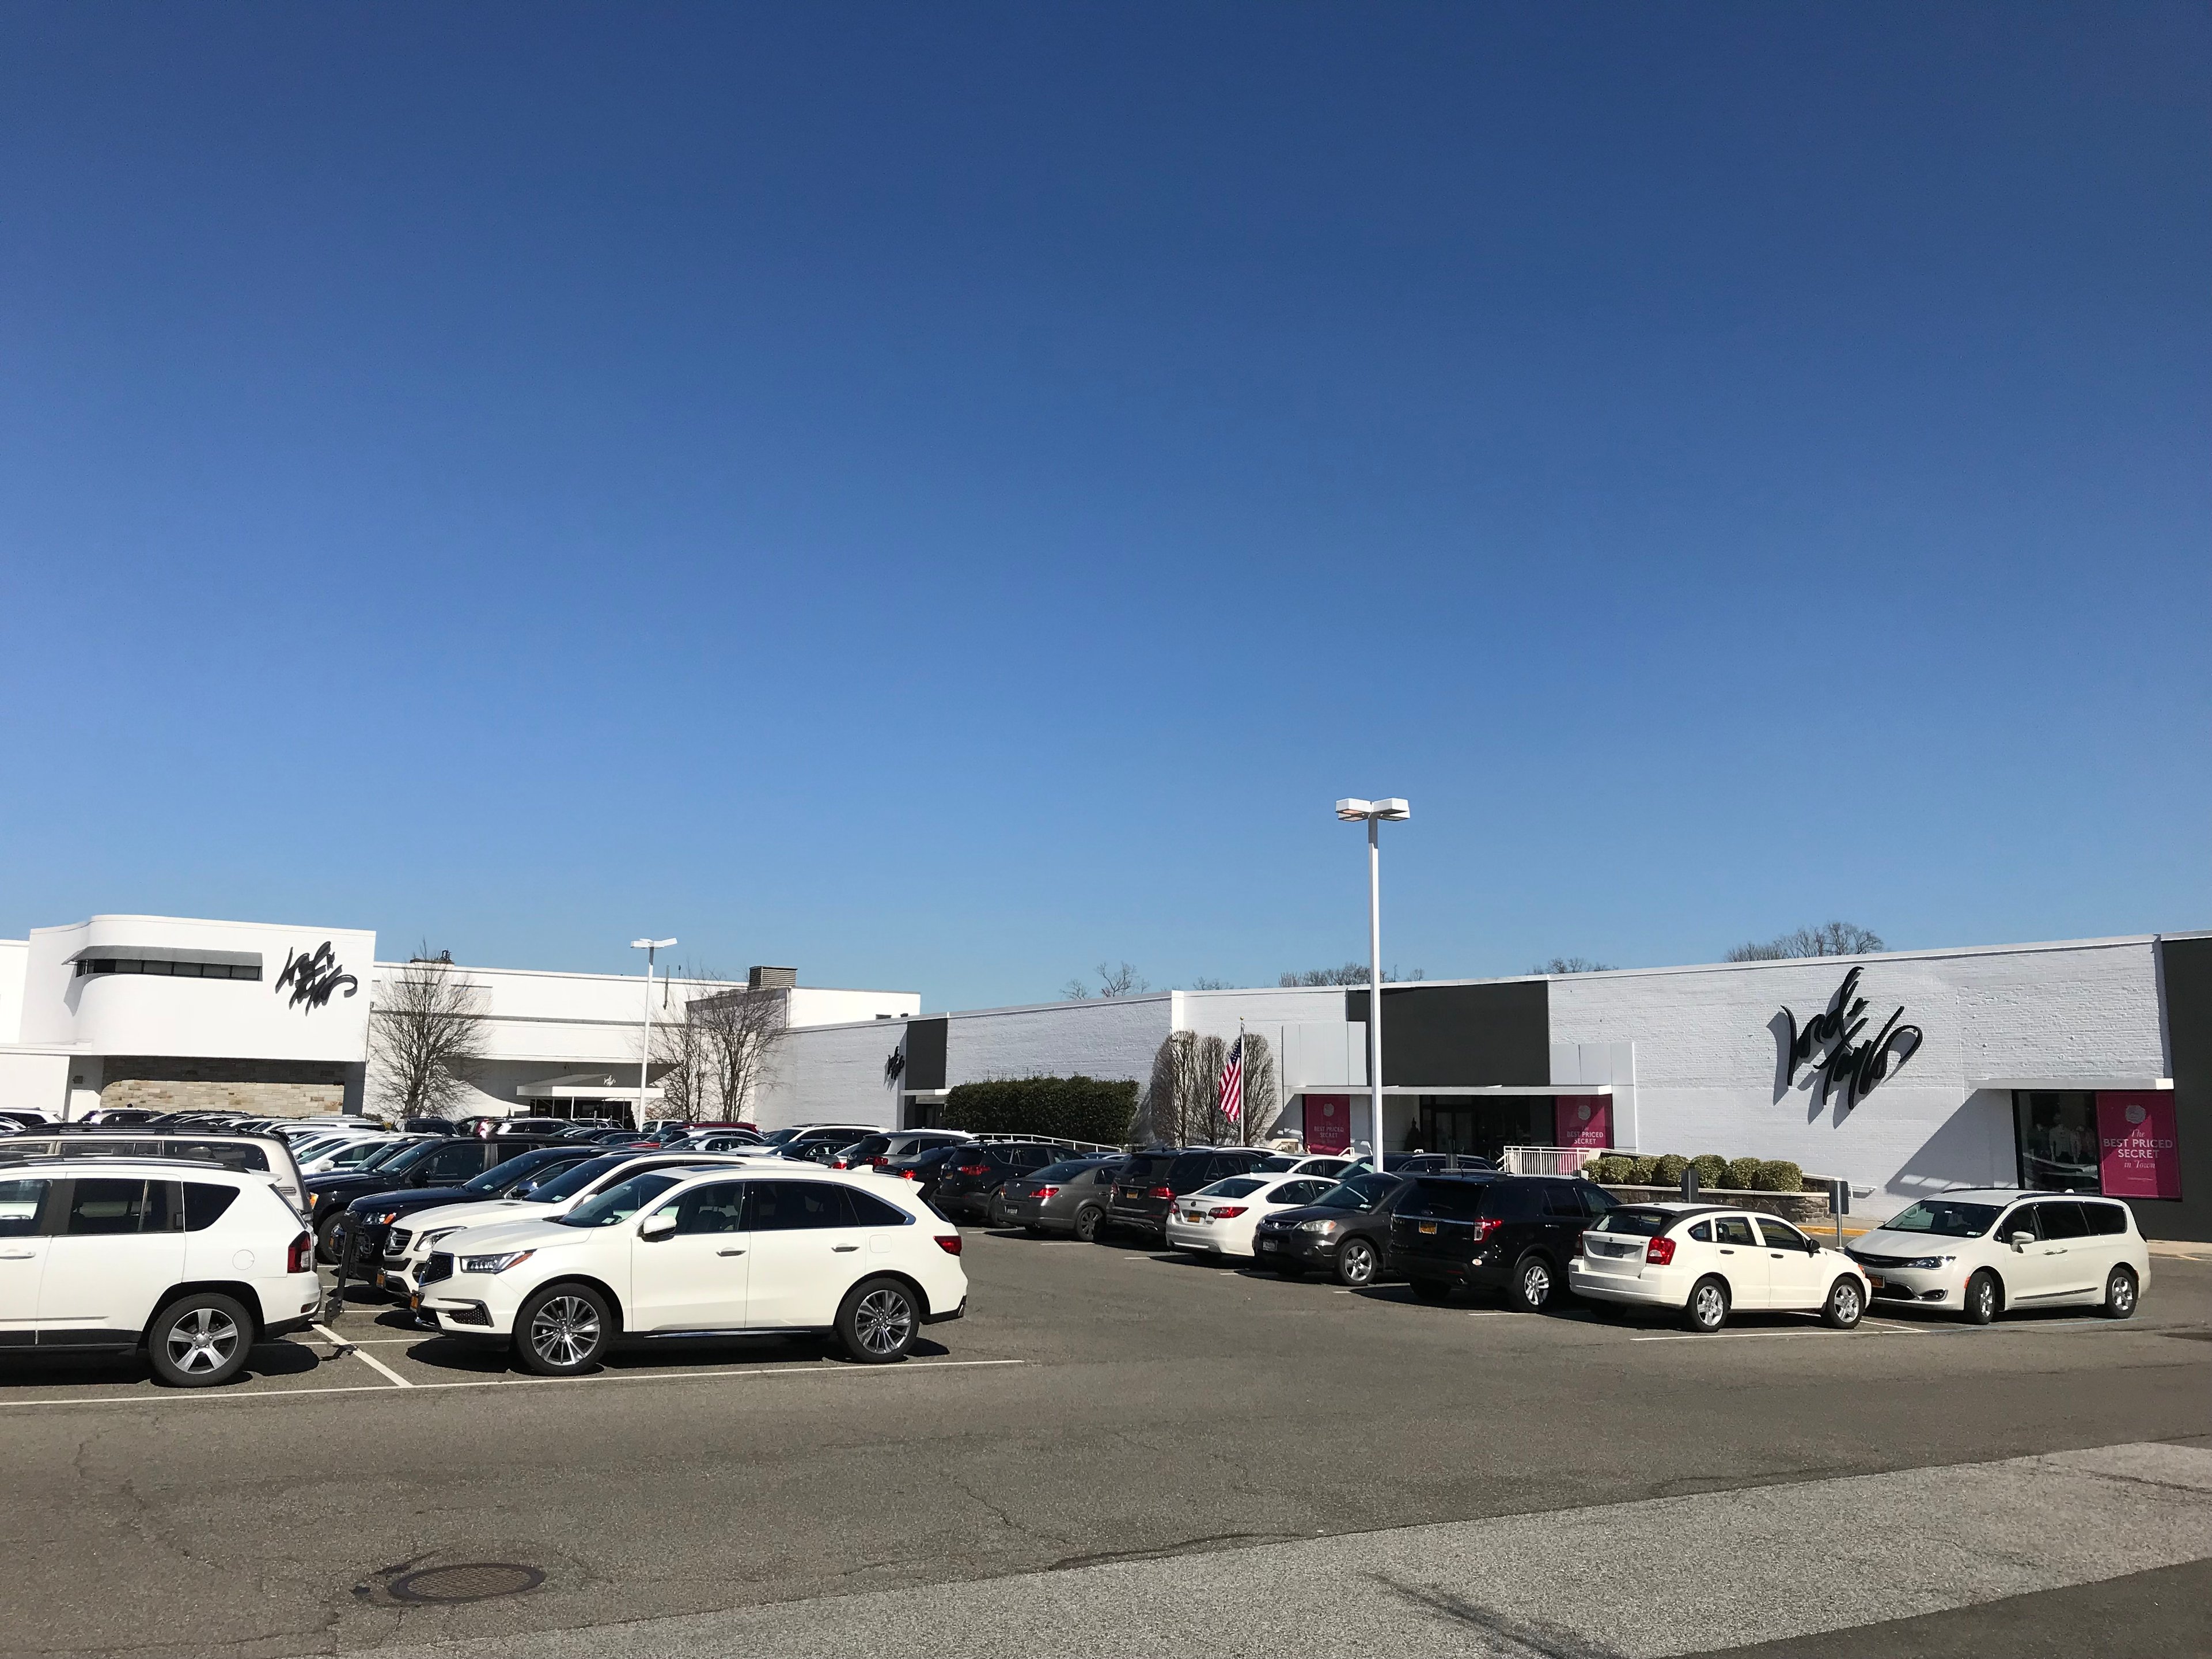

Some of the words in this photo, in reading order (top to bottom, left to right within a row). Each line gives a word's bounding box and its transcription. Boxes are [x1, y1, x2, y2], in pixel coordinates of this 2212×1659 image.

[2131, 1129, 2145, 1138] The
[2103, 1139, 2128, 1147] BEST
[2133, 1139, 2173, 1149] PRICED
[2118, 1149, 2160, 1158] SECRET
[2124, 1160, 2131, 1168] in
[2134, 1160, 2156, 1169] Town
